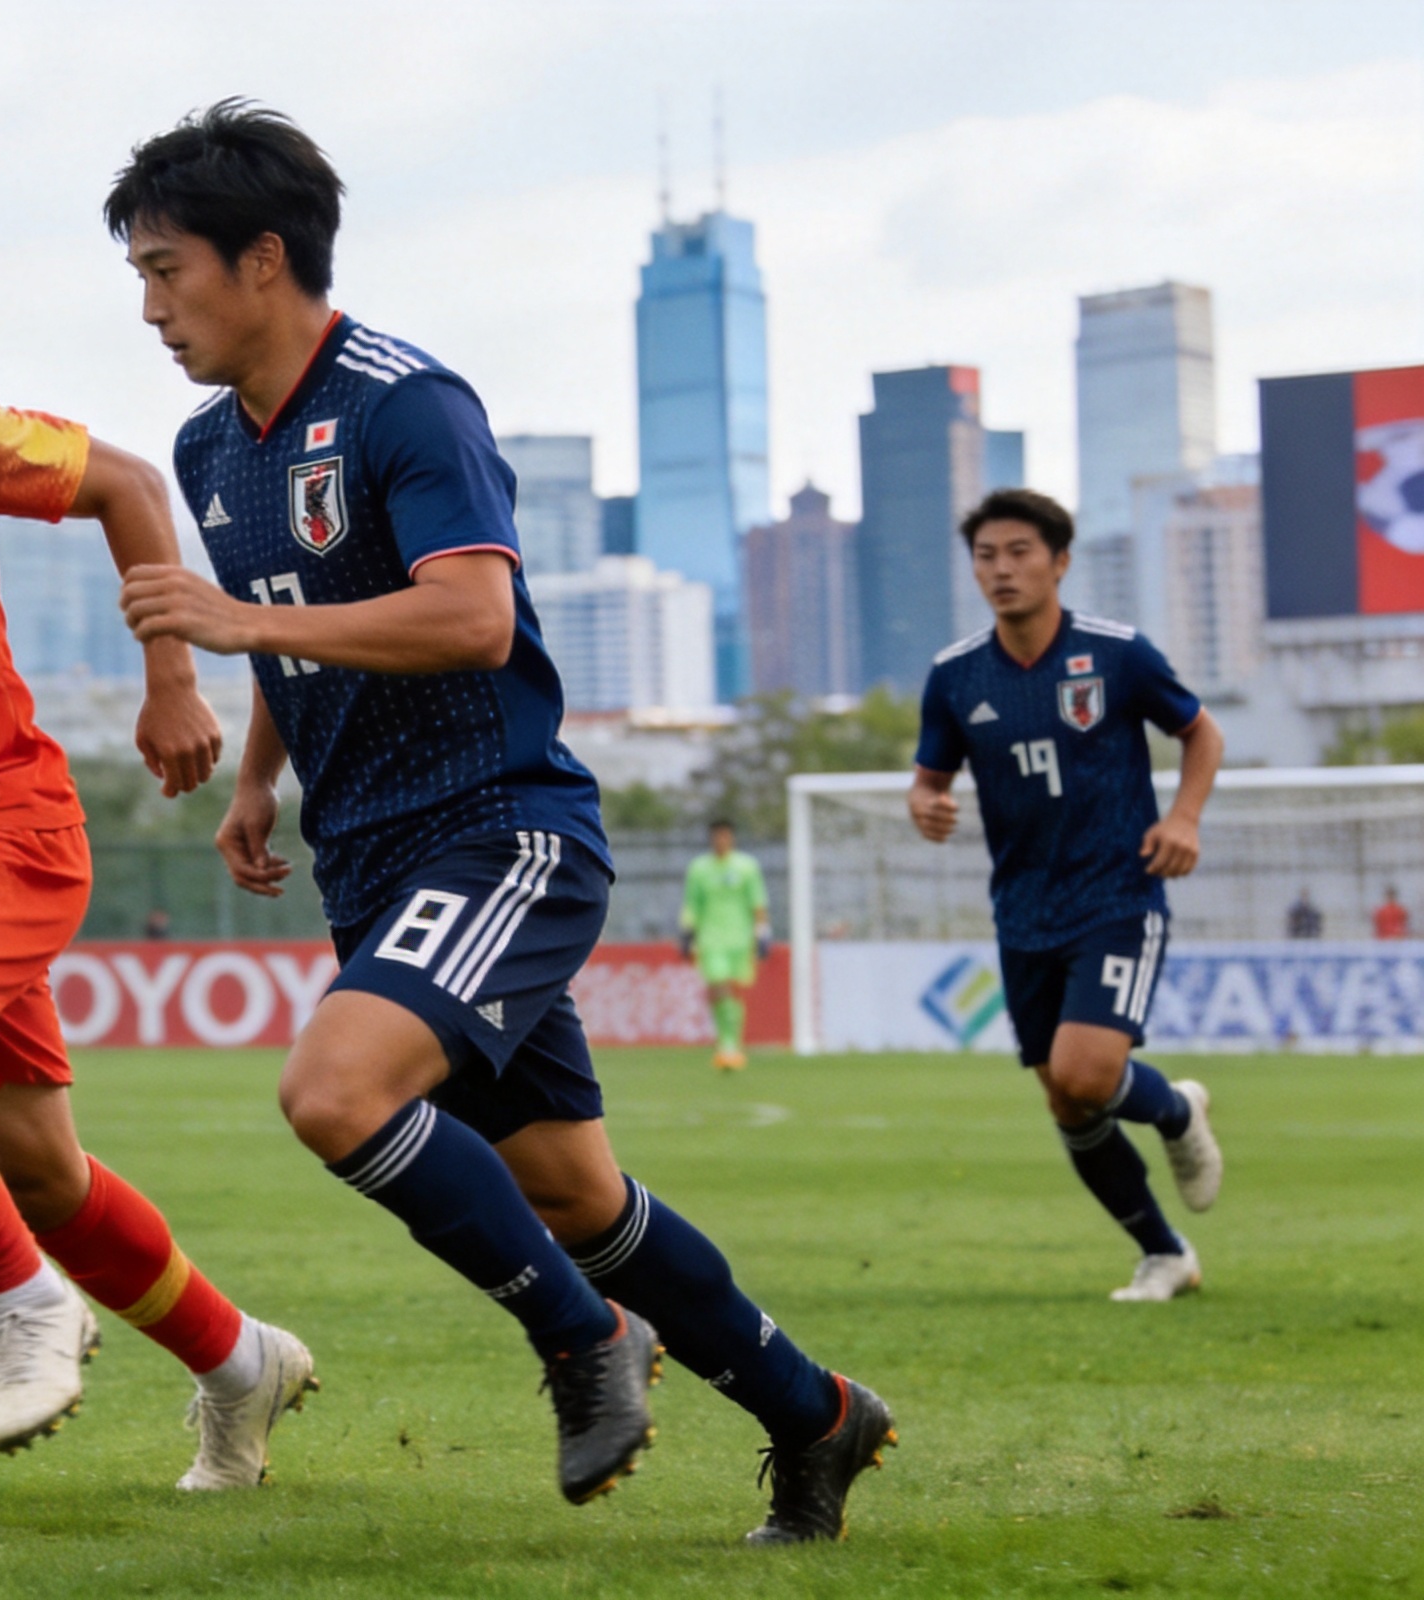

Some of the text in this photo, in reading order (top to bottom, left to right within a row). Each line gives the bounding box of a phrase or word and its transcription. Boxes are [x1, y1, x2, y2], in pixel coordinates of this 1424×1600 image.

[1009, 738, 1063, 797] 19
[374, 889, 470, 970] 8
[1100, 953, 1136, 1016] 9
